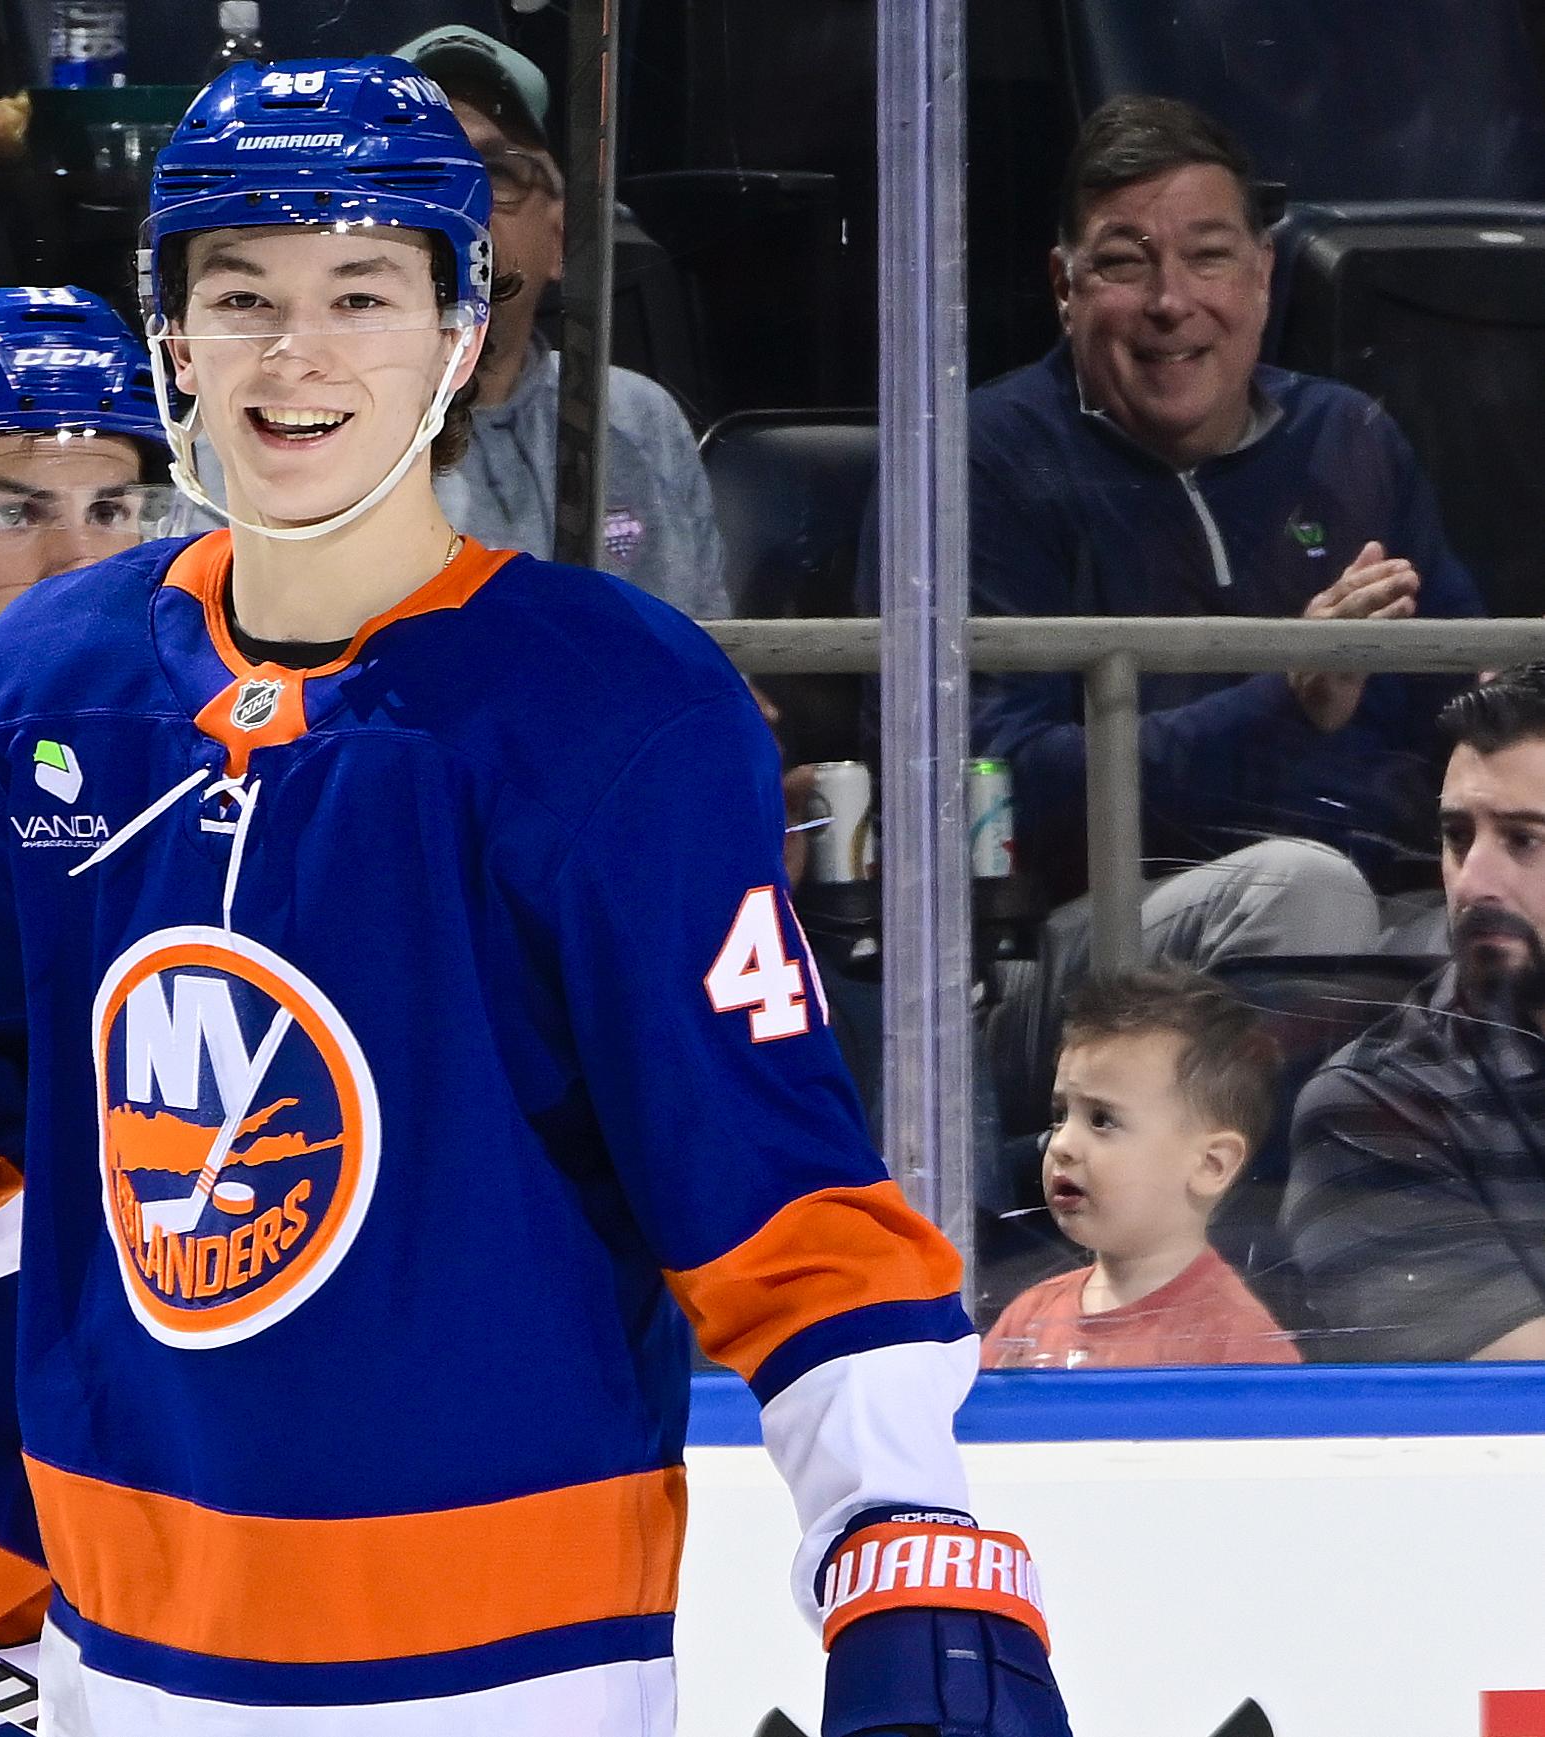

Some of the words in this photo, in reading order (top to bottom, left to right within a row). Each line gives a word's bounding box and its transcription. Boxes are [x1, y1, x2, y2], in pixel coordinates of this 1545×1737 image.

[236, 133, 344, 151] WARRIOR
[14, 348, 115, 368] CCM
[239, 692, 273, 720] NHL
[10, 815, 109, 839] VANDA
[703, 884, 830, 1044] 4
[126, 973, 293, 1135] NY
